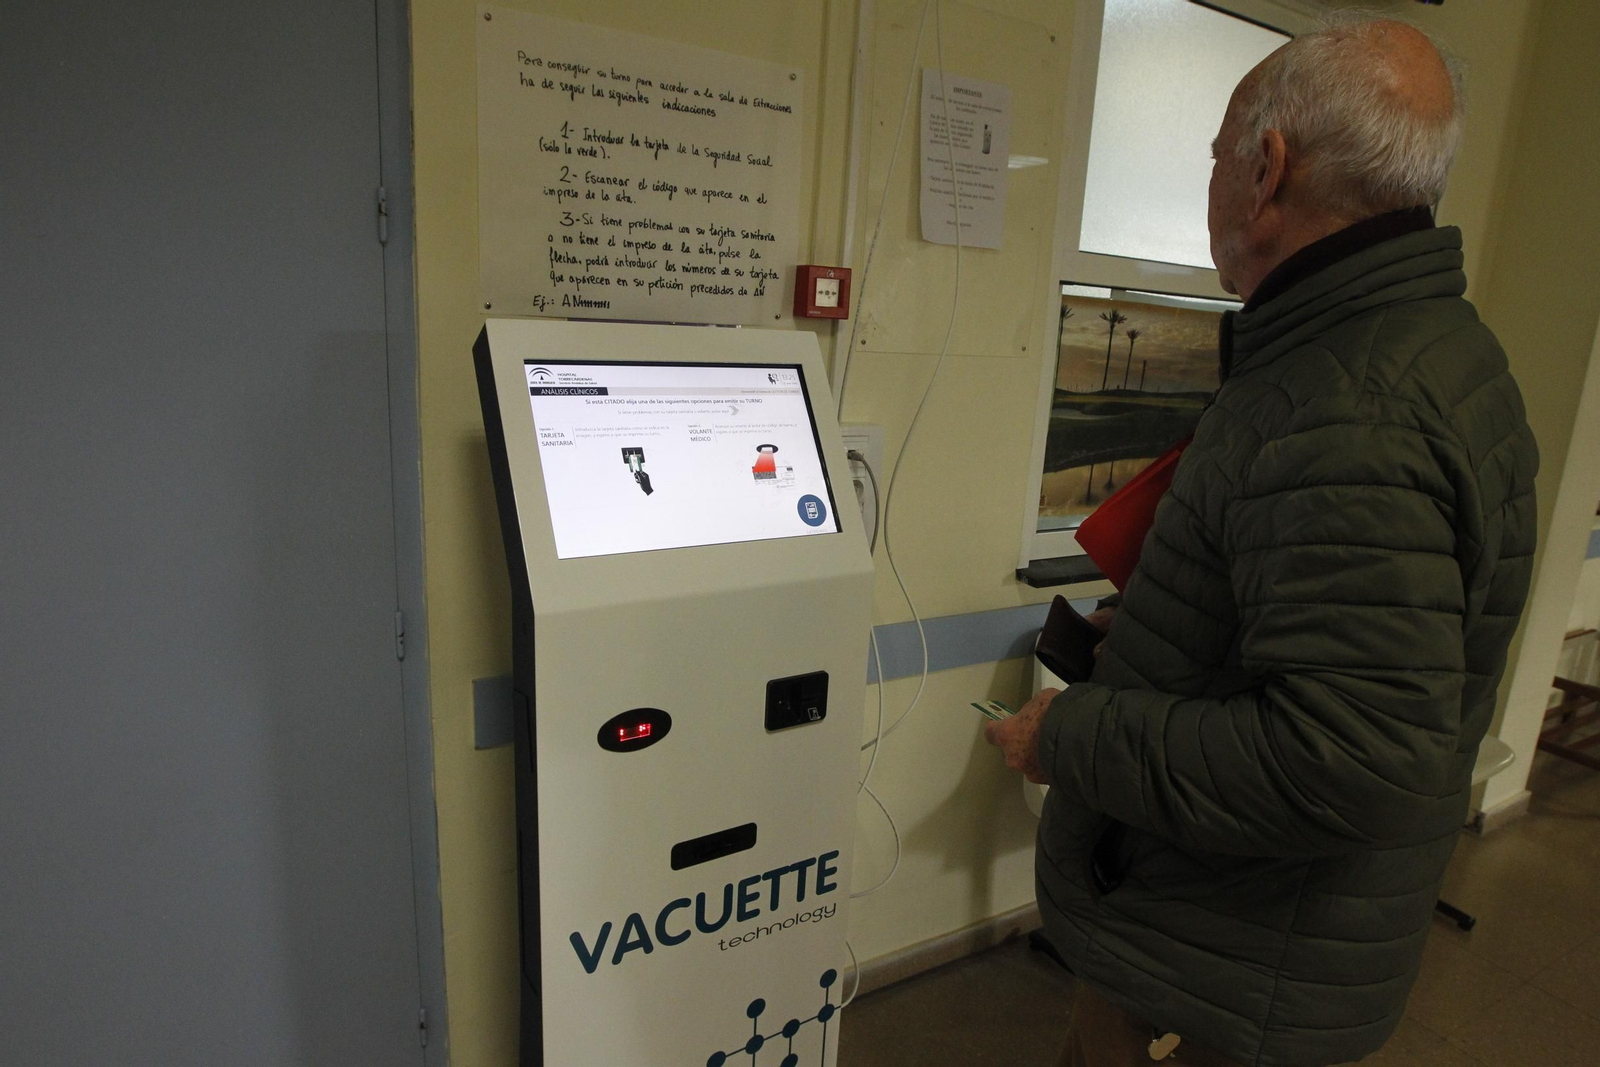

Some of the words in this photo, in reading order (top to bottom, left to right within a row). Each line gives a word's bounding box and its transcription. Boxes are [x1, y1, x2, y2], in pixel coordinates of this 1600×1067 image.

[518, 50, 542, 66] Para
[548, 60, 590, 78] conseguir
[611, 67, 631, 82] turno
[636, 78, 652, 89] para
[660, 82, 688, 94] acceder
[704, 88, 714, 98] la
[719, 91, 734, 102] sala
[738, 96, 748, 106] de
[753, 98, 792, 114] Extracciones
[520, 72, 535, 87] ha
[542, 78, 554, 90] de
[560, 82, 585, 101] seguir
[592, 84, 604, 98] las
[608, 90, 650, 106] siguientes
[662, 98, 716, 117] indicaciones
[564, 142, 572, 154] la
[630, 133, 640, 147] la
[644, 136, 669, 160] tarjeta
[677, 143, 686, 154] de
[692, 144, 700, 156] la
[704, 147, 742, 168] Seguridad
[747, 154, 773, 167] Social
[543, 186, 578, 204] impreso
[586, 190, 595, 200] de
[601, 189, 610, 201] la
[585, 171, 630, 187] Escanear
[638, 178, 648, 190] el
[652, 181, 678, 201] código
[685, 187, 697, 196] que
[702, 190, 733, 203] aparece
[739, 194, 749, 203] en
[757, 193, 767, 204] el
[600, 213, 622, 227] tiene
[629, 218, 673, 235] problemas
[678, 226, 690, 234] con
[709, 223, 736, 247] tarjeta
[548, 234, 553, 242] o
[563, 235, 573, 244] no
[579, 231, 599, 246] tiene
[608, 235, 616, 247] el
[623, 239, 656, 255] impreso
[662, 242, 673, 252] de
[681, 242, 691, 253] la
[719, 246, 741, 264] pulse
[749, 248, 761, 259] la
[569, 275, 611, 292] aparecen
[617, 277, 628, 287] en
[633, 278, 644, 287] su
[648, 276, 684, 296] petición
[690, 284, 734, 298] precedidos
[738, 287, 748, 296] de
[754, 286, 766, 297] AN
[586, 255, 609, 272] podrá
[665, 260, 676, 272] los
[682, 263, 716, 275] números
[721, 267, 731, 276] de
[734, 269, 744, 277] su
[749, 266, 779, 288] tarjeta
[568, 850, 840, 975] VACUETTE
[717, 902, 837, 952] technology
